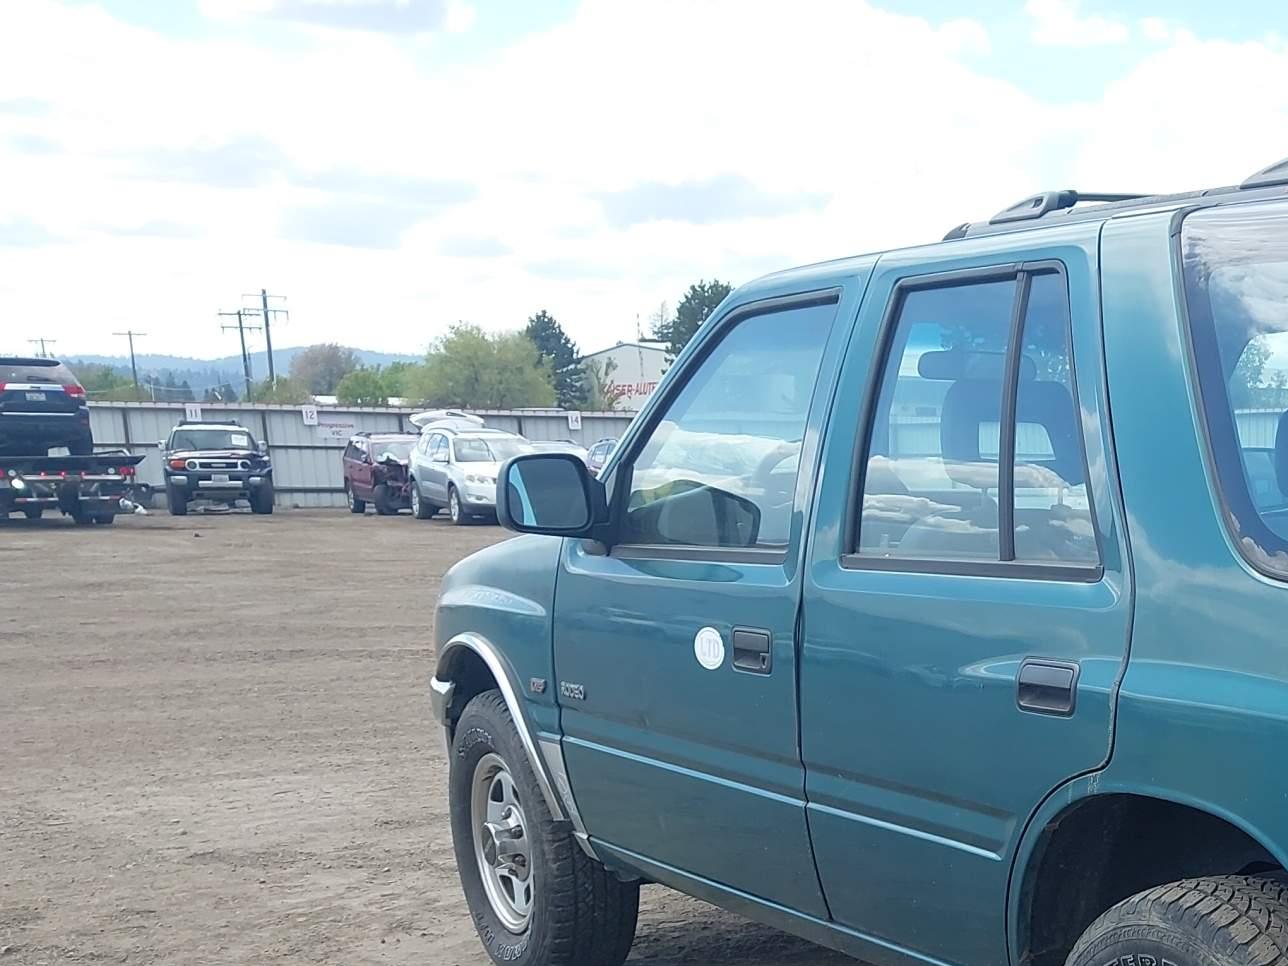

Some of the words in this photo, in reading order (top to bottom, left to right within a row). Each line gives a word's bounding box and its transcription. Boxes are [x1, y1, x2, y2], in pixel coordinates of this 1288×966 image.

[189, 408, 198, 419] 11
[305, 409, 315, 420] 12
[570, 416, 579, 425] 14
